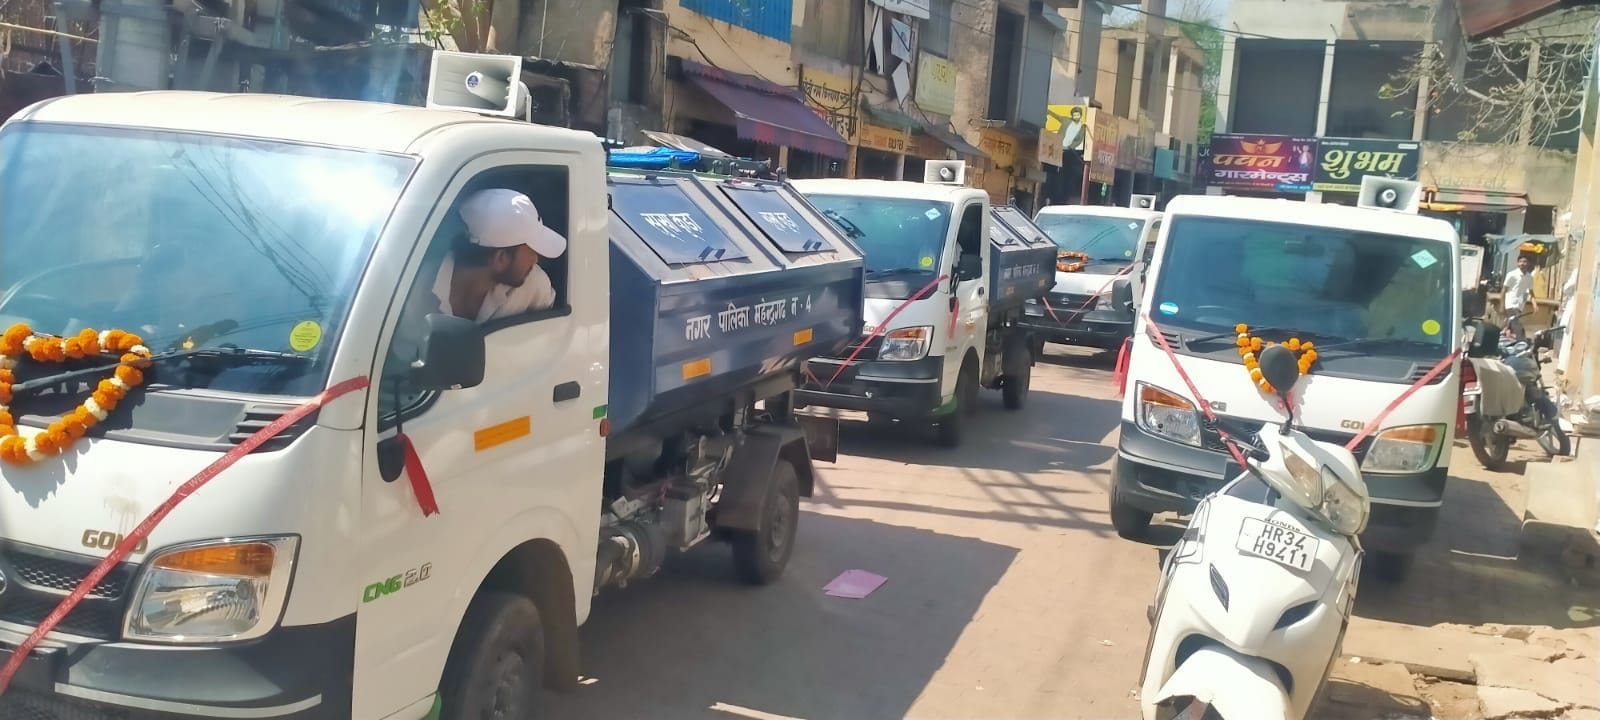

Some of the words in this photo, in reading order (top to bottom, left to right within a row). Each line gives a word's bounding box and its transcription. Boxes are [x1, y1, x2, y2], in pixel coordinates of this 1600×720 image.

[1213, 153, 1286, 168] पवन
[1321, 149, 1407, 180] शुभम
[685, 314, 712, 341] नगर
[718, 302, 750, 333] पालिका
[805, 294, 812, 313] 4
[864, 325, 886, 333] GOD
[1341, 419, 1379, 431] GO
[1253, 535, 1307, 568] H9411
[1262, 524, 1306, 550] HR34
[70, 559, 112, 601] WEOME
[362, 573, 403, 603] CNG
